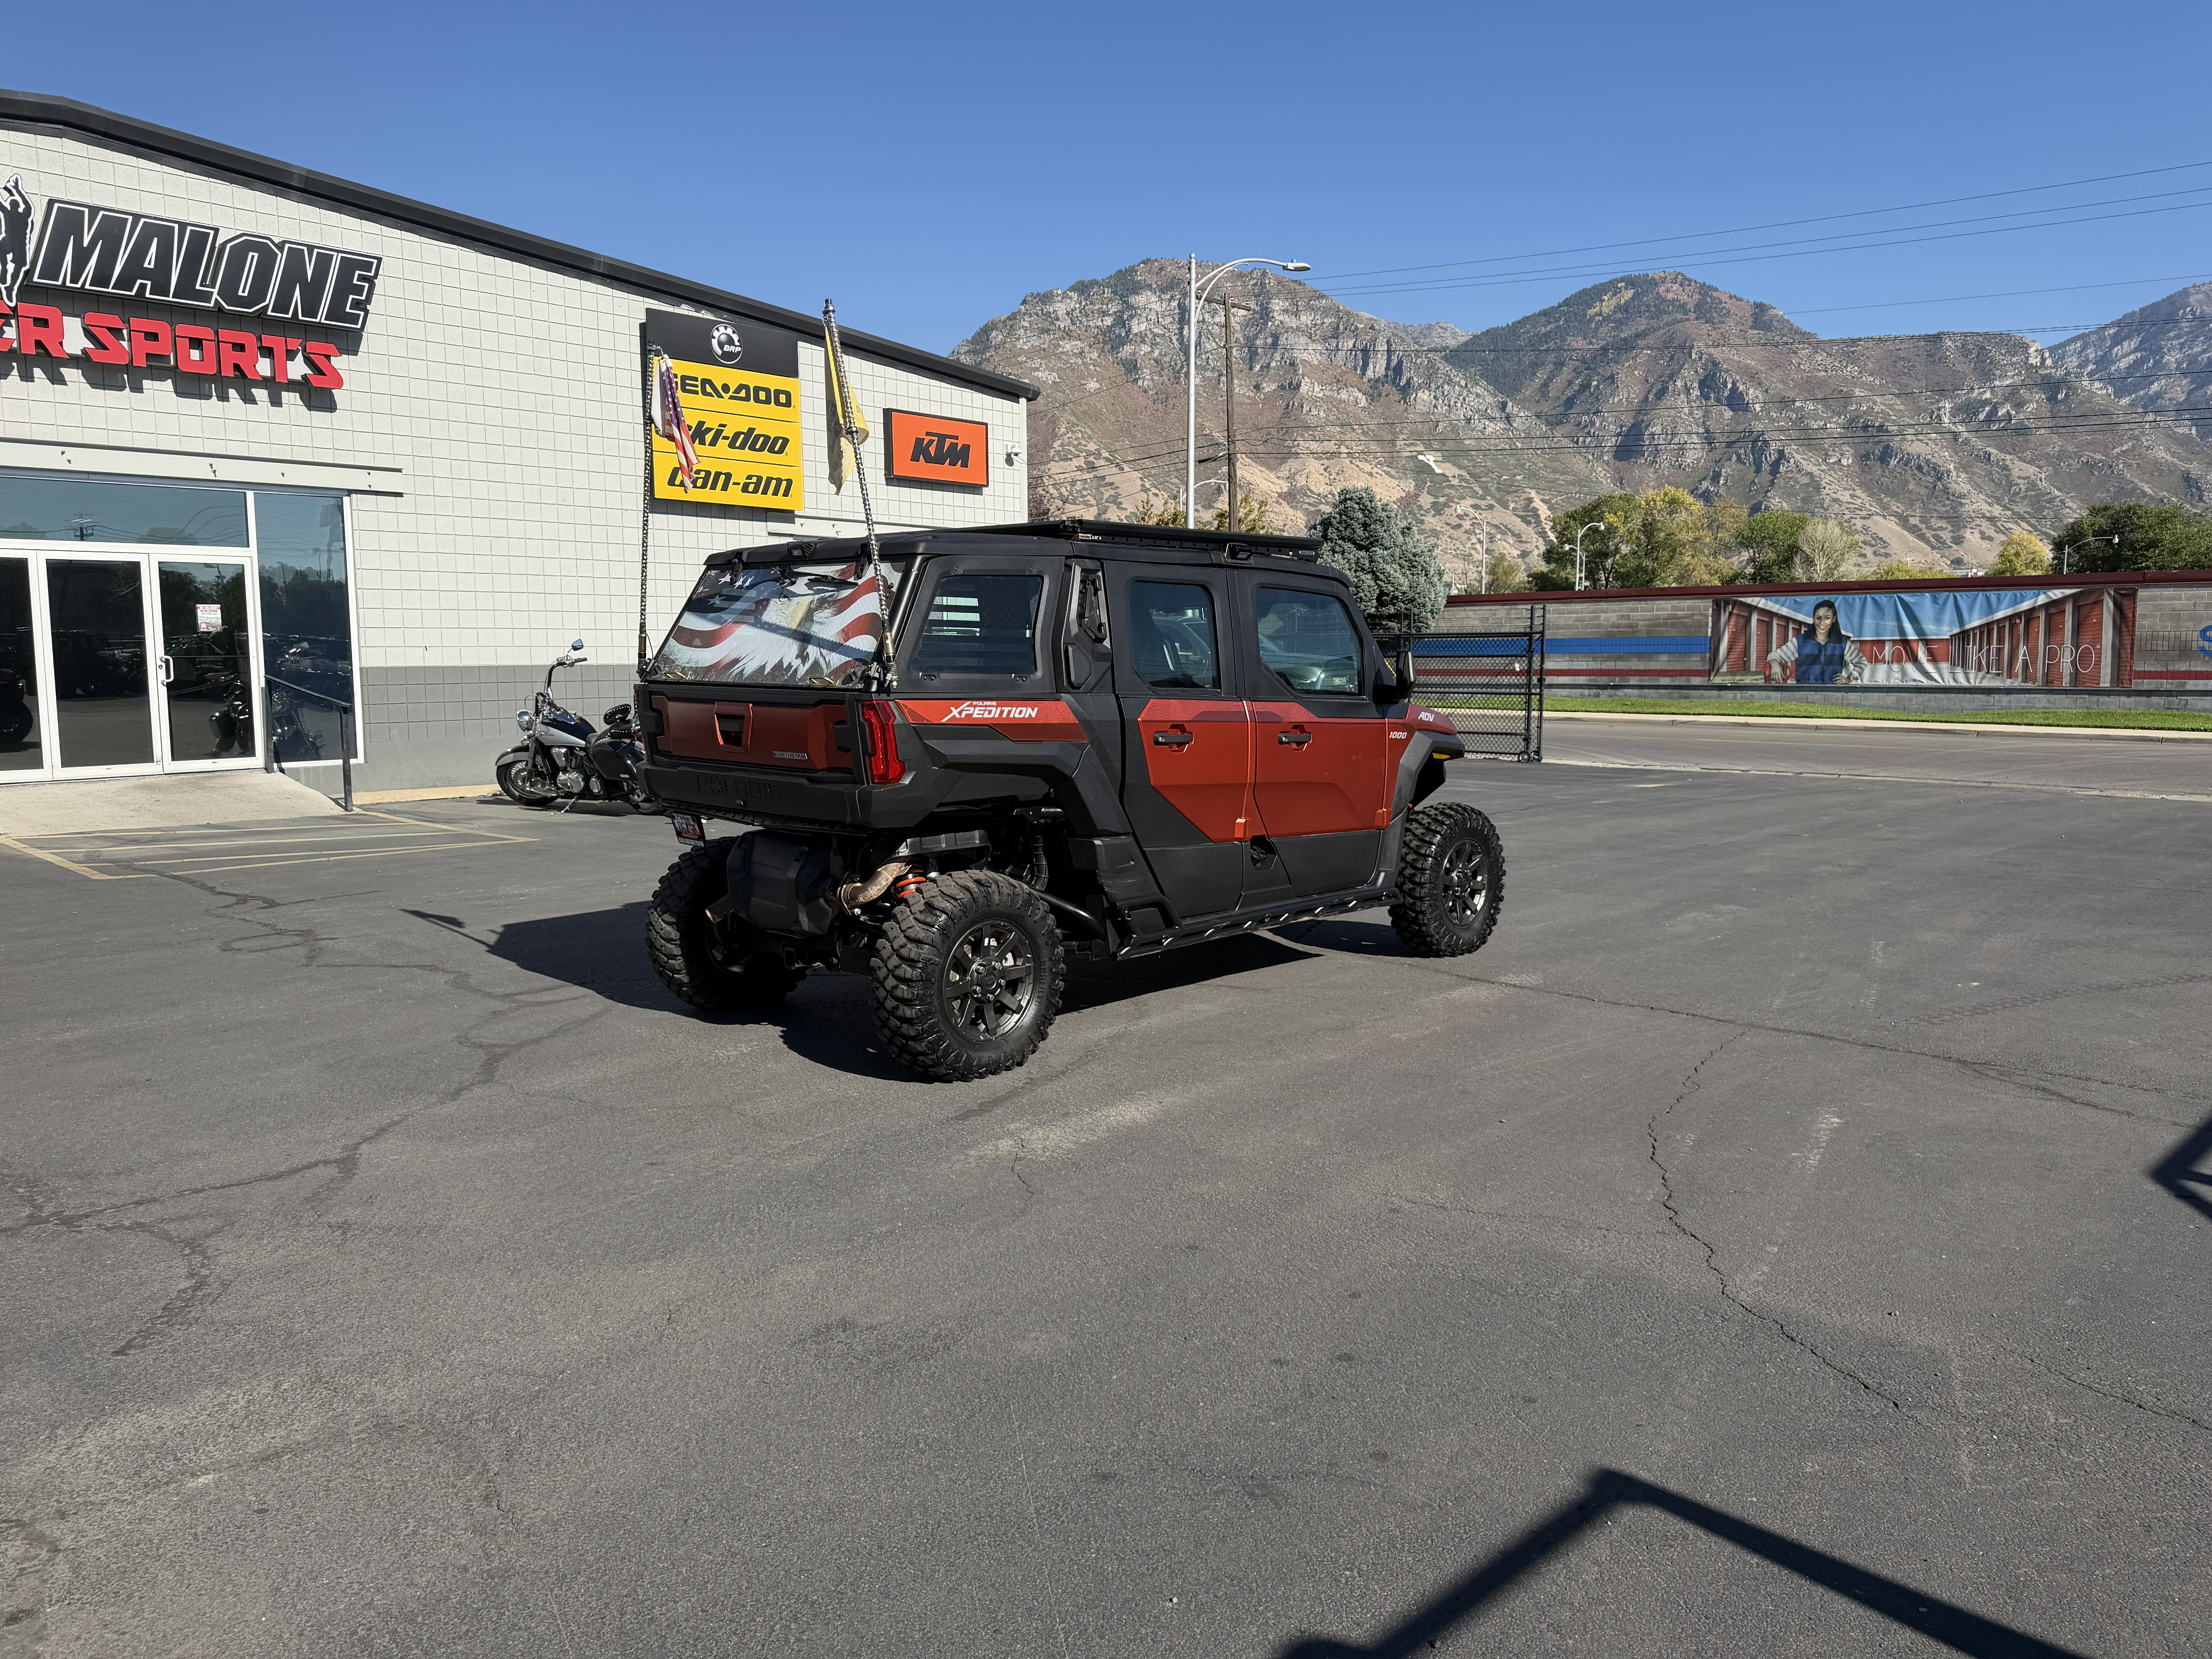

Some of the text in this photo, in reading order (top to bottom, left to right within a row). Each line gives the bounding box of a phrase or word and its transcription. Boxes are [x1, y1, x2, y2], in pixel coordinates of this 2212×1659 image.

[34, 203, 382, 330] MALONE
[83, 312, 343, 390] SPORTS
[723, 344, 741, 353] BRP
[910, 431, 970, 468] KTM
[1872, 646, 1939, 673] MOVE
[1949, 645, 2004, 673] LIKE
[2015, 645, 2032, 673] A
[940, 701, 1038, 722] XPEDITION
[1418, 711, 1434, 722] ADV
